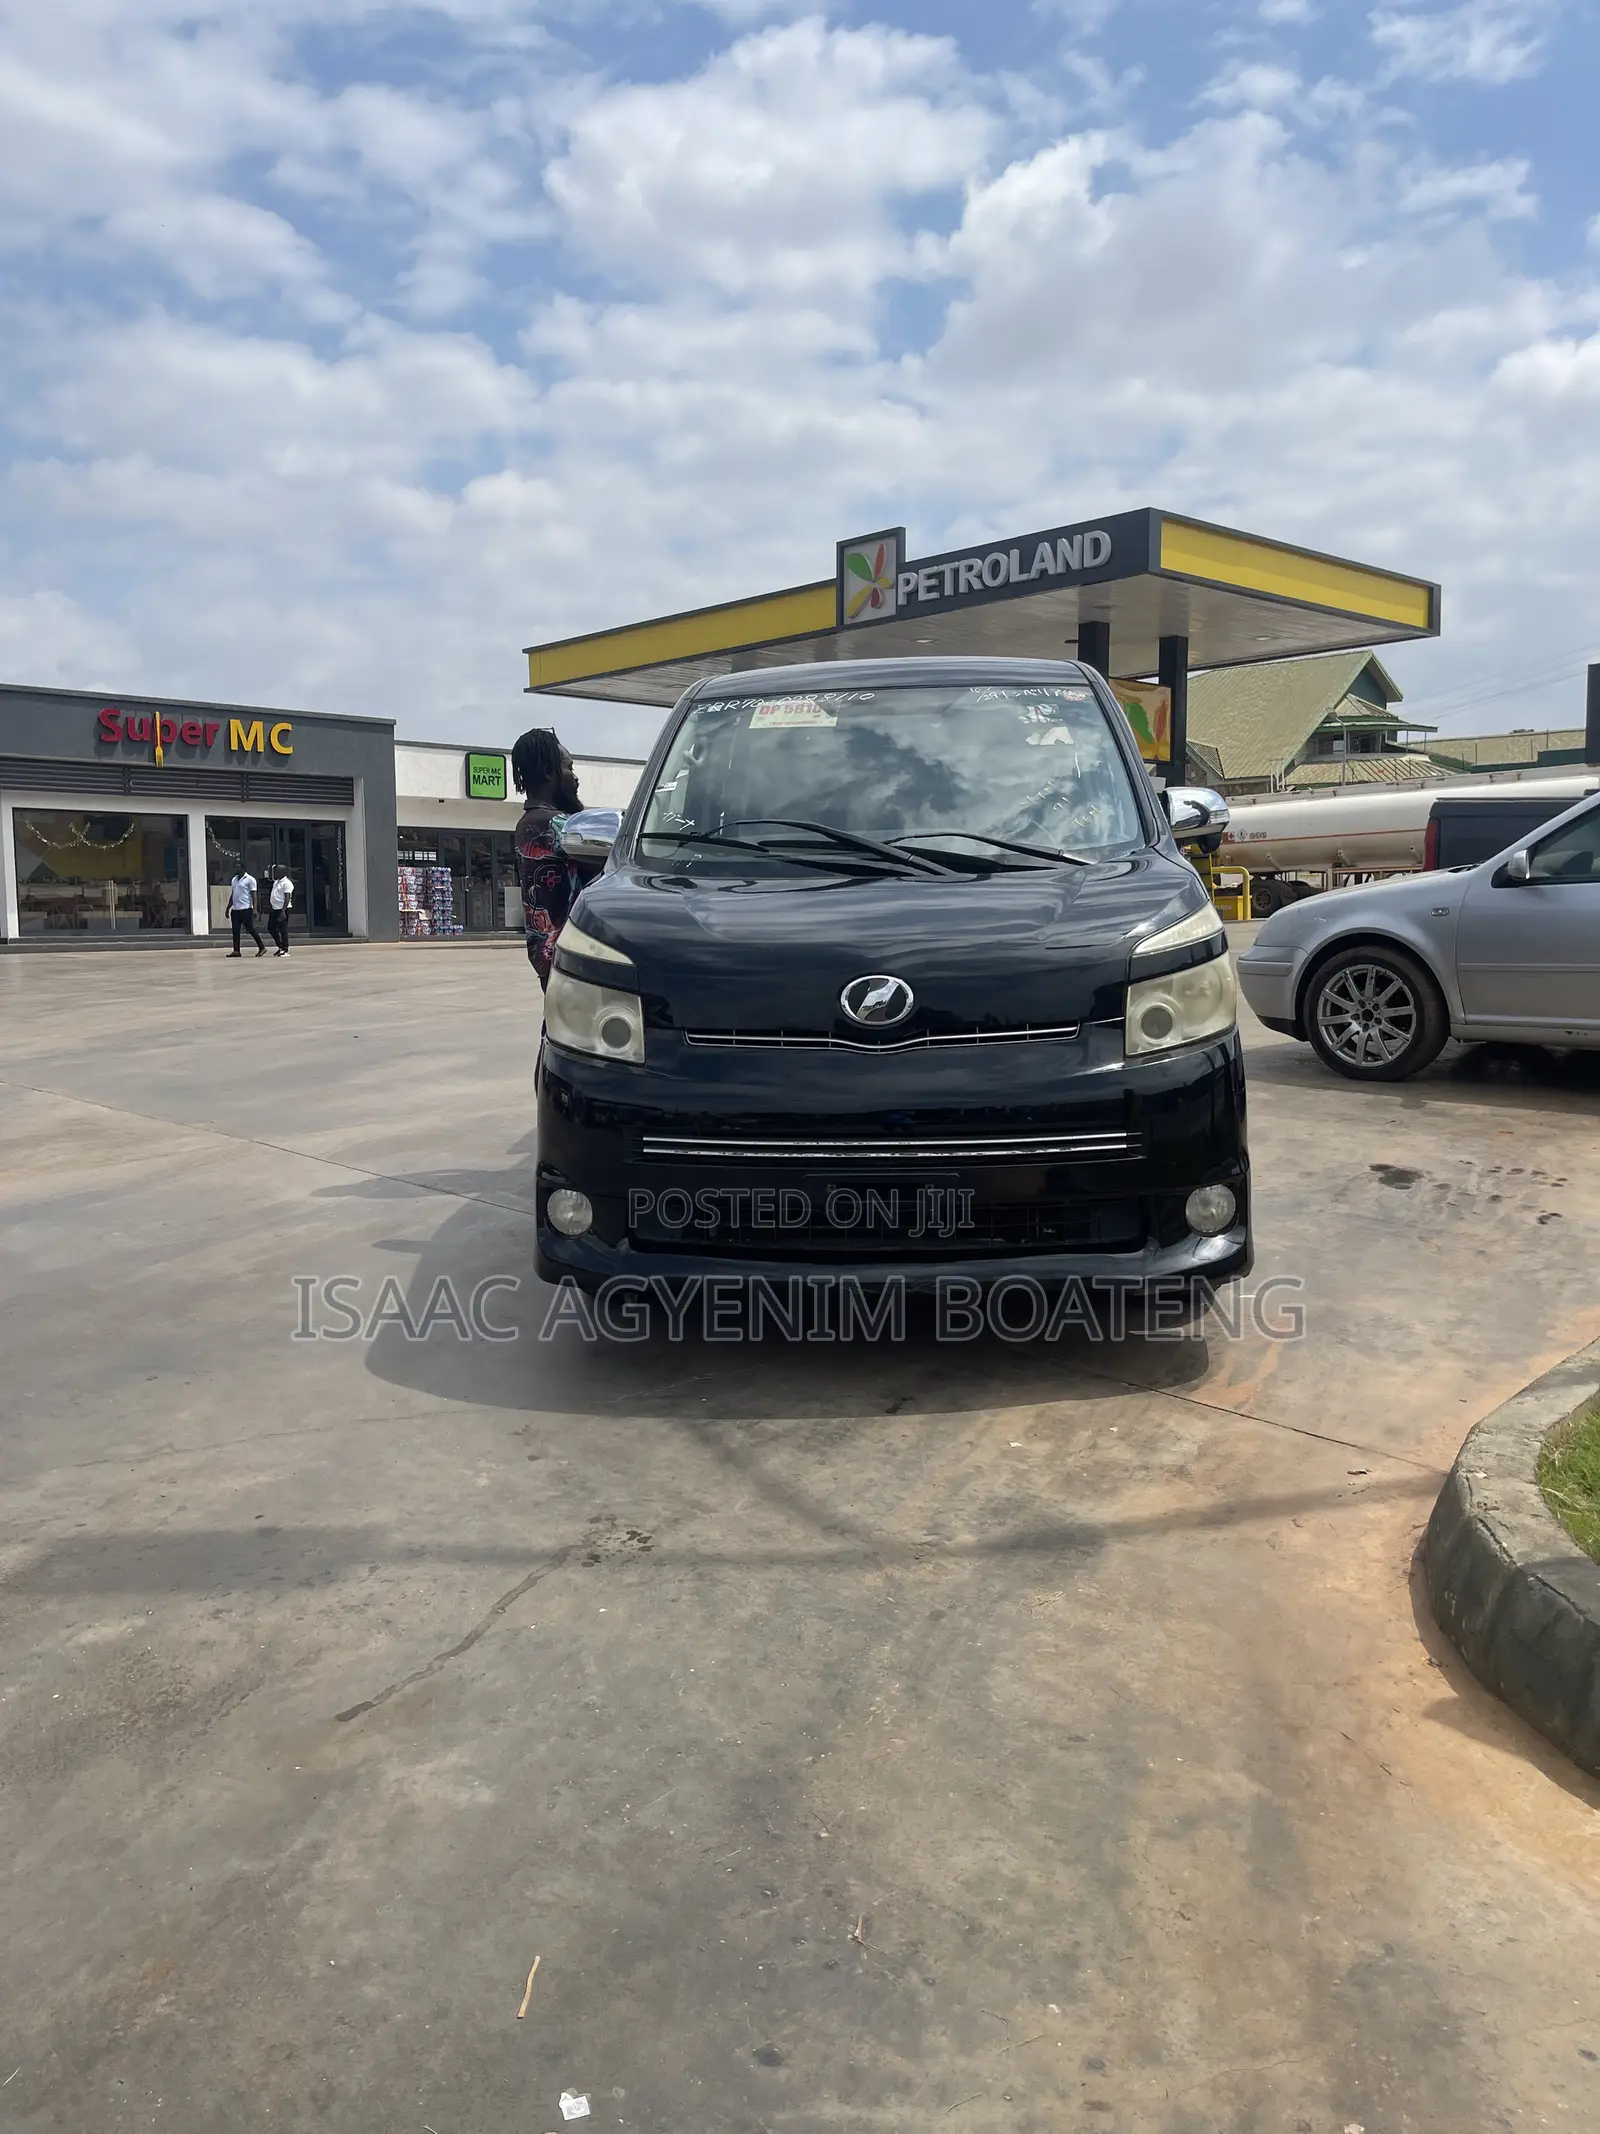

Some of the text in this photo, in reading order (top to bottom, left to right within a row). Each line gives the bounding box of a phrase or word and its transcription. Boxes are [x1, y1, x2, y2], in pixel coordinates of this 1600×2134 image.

[897, 530, 1112, 606] PETROLAND
[98, 707, 294, 755] Super MC
[472, 774, 502, 786] MART
[473, 766, 490, 775] SUPER
